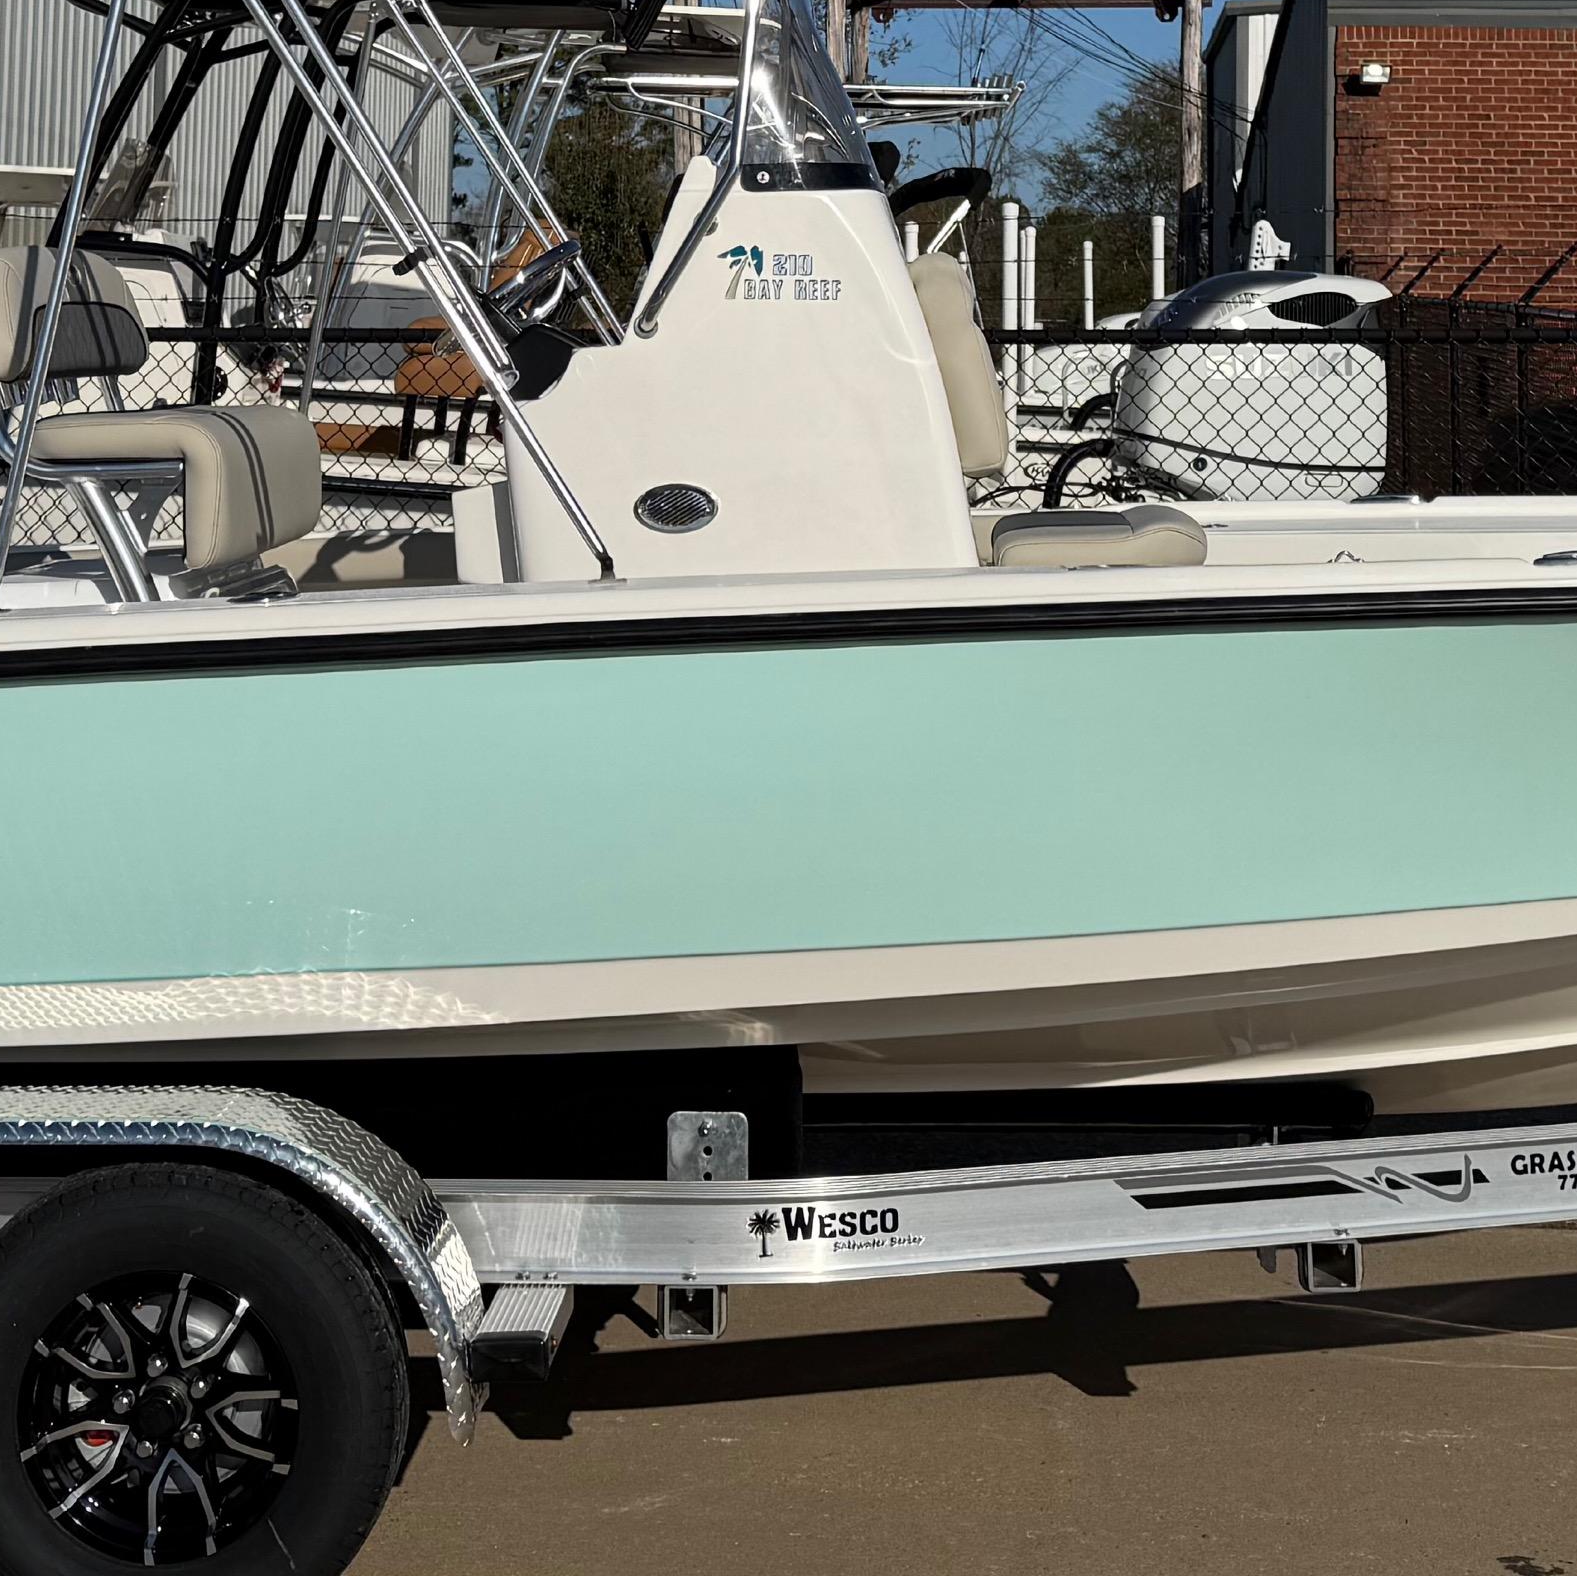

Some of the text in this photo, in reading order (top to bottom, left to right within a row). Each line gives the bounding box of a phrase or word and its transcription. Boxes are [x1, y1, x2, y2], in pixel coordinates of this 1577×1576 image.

[772, 254, 813, 276] 210
[743, 279, 842, 301] BAY REEF
[781, 1206, 900, 1242] WESCO
